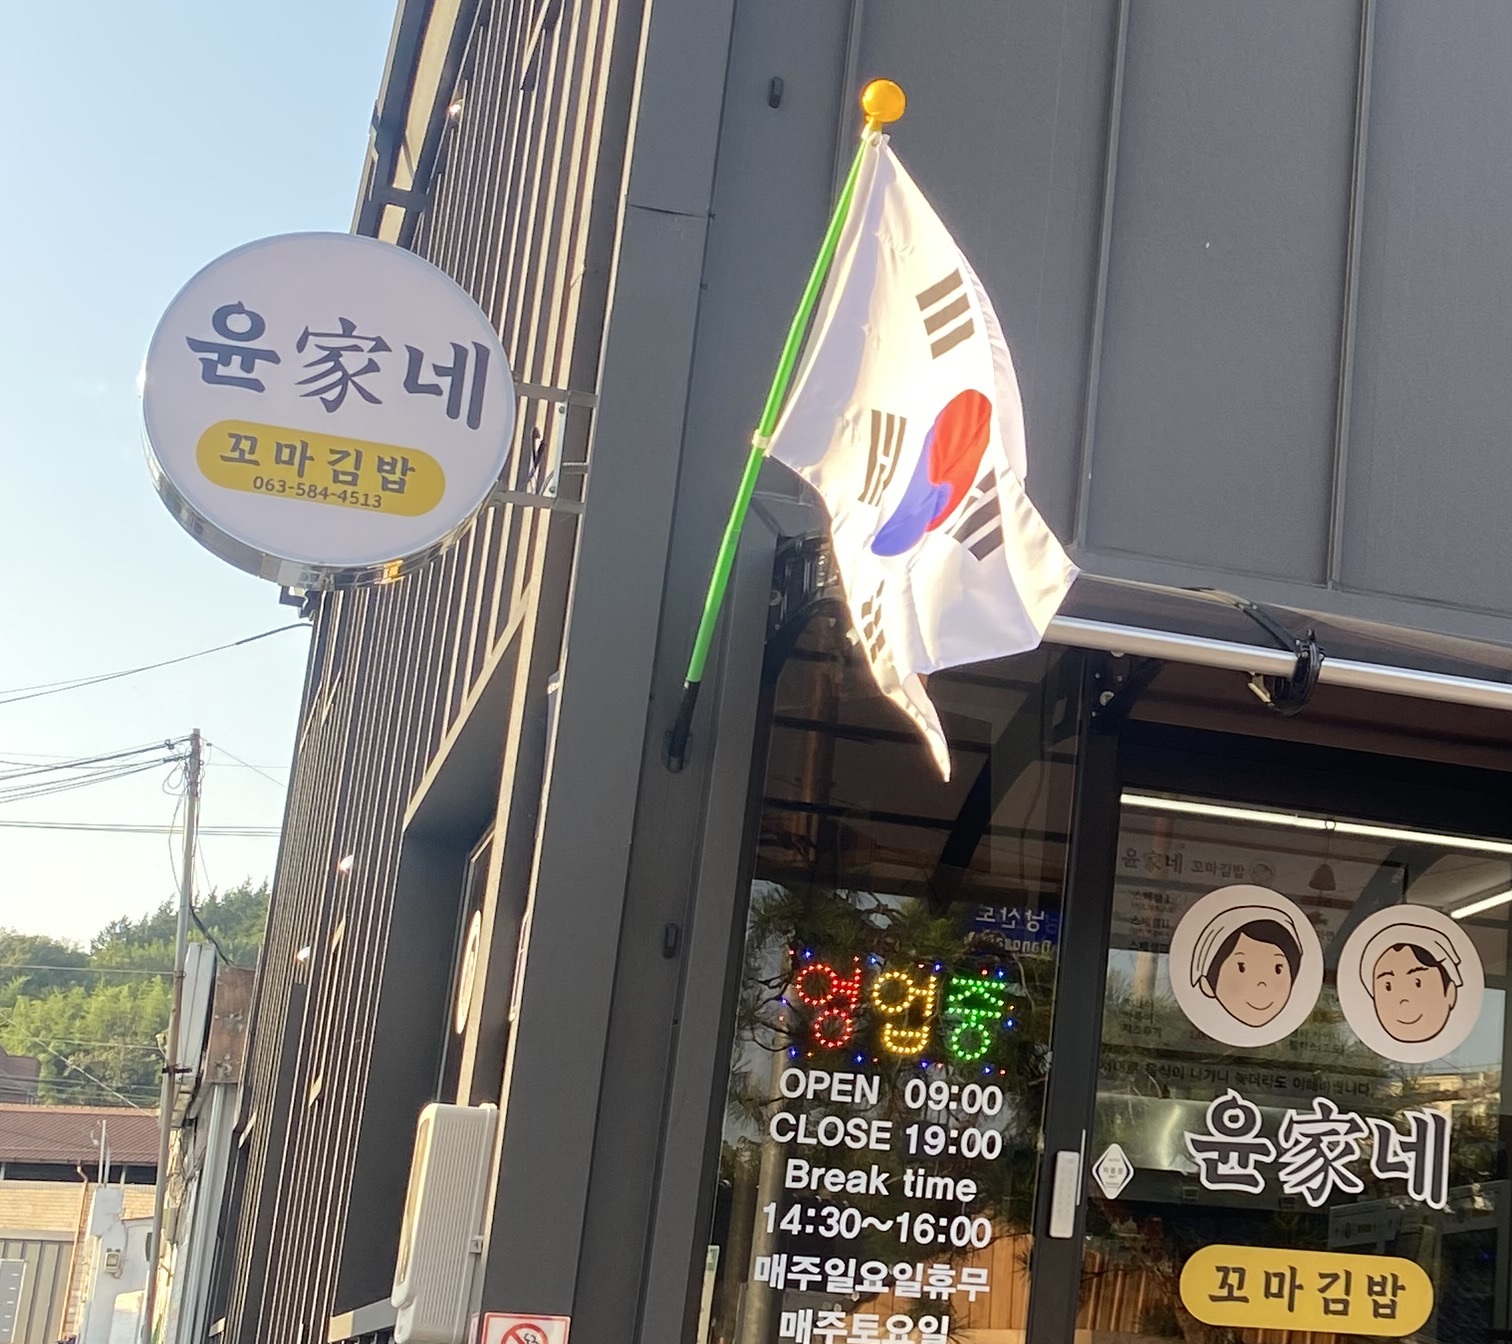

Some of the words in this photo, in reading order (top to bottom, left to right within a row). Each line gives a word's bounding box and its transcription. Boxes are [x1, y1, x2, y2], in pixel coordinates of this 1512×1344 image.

[219, 432, 416, 494] 꼬마김밥
[252, 475, 383, 509] 063-584-4513
[796, 956, 1006, 1061] 영업중
[779, 1067, 879, 1106] OPEN
[904, 1078, 1003, 1116] 09:00
[768, 1111, 893, 1153] CLOSE
[905, 1123, 1002, 1160] 19:00
[784, 1157, 889, 1198] Break
[904, 1166, 978, 1204] time
[762, 1203, 993, 1250] 14:30~16:00
[753, 1254, 991, 1302] 매주일요일휴무
[1208, 1264, 1406, 1320] 꼬마김밥
